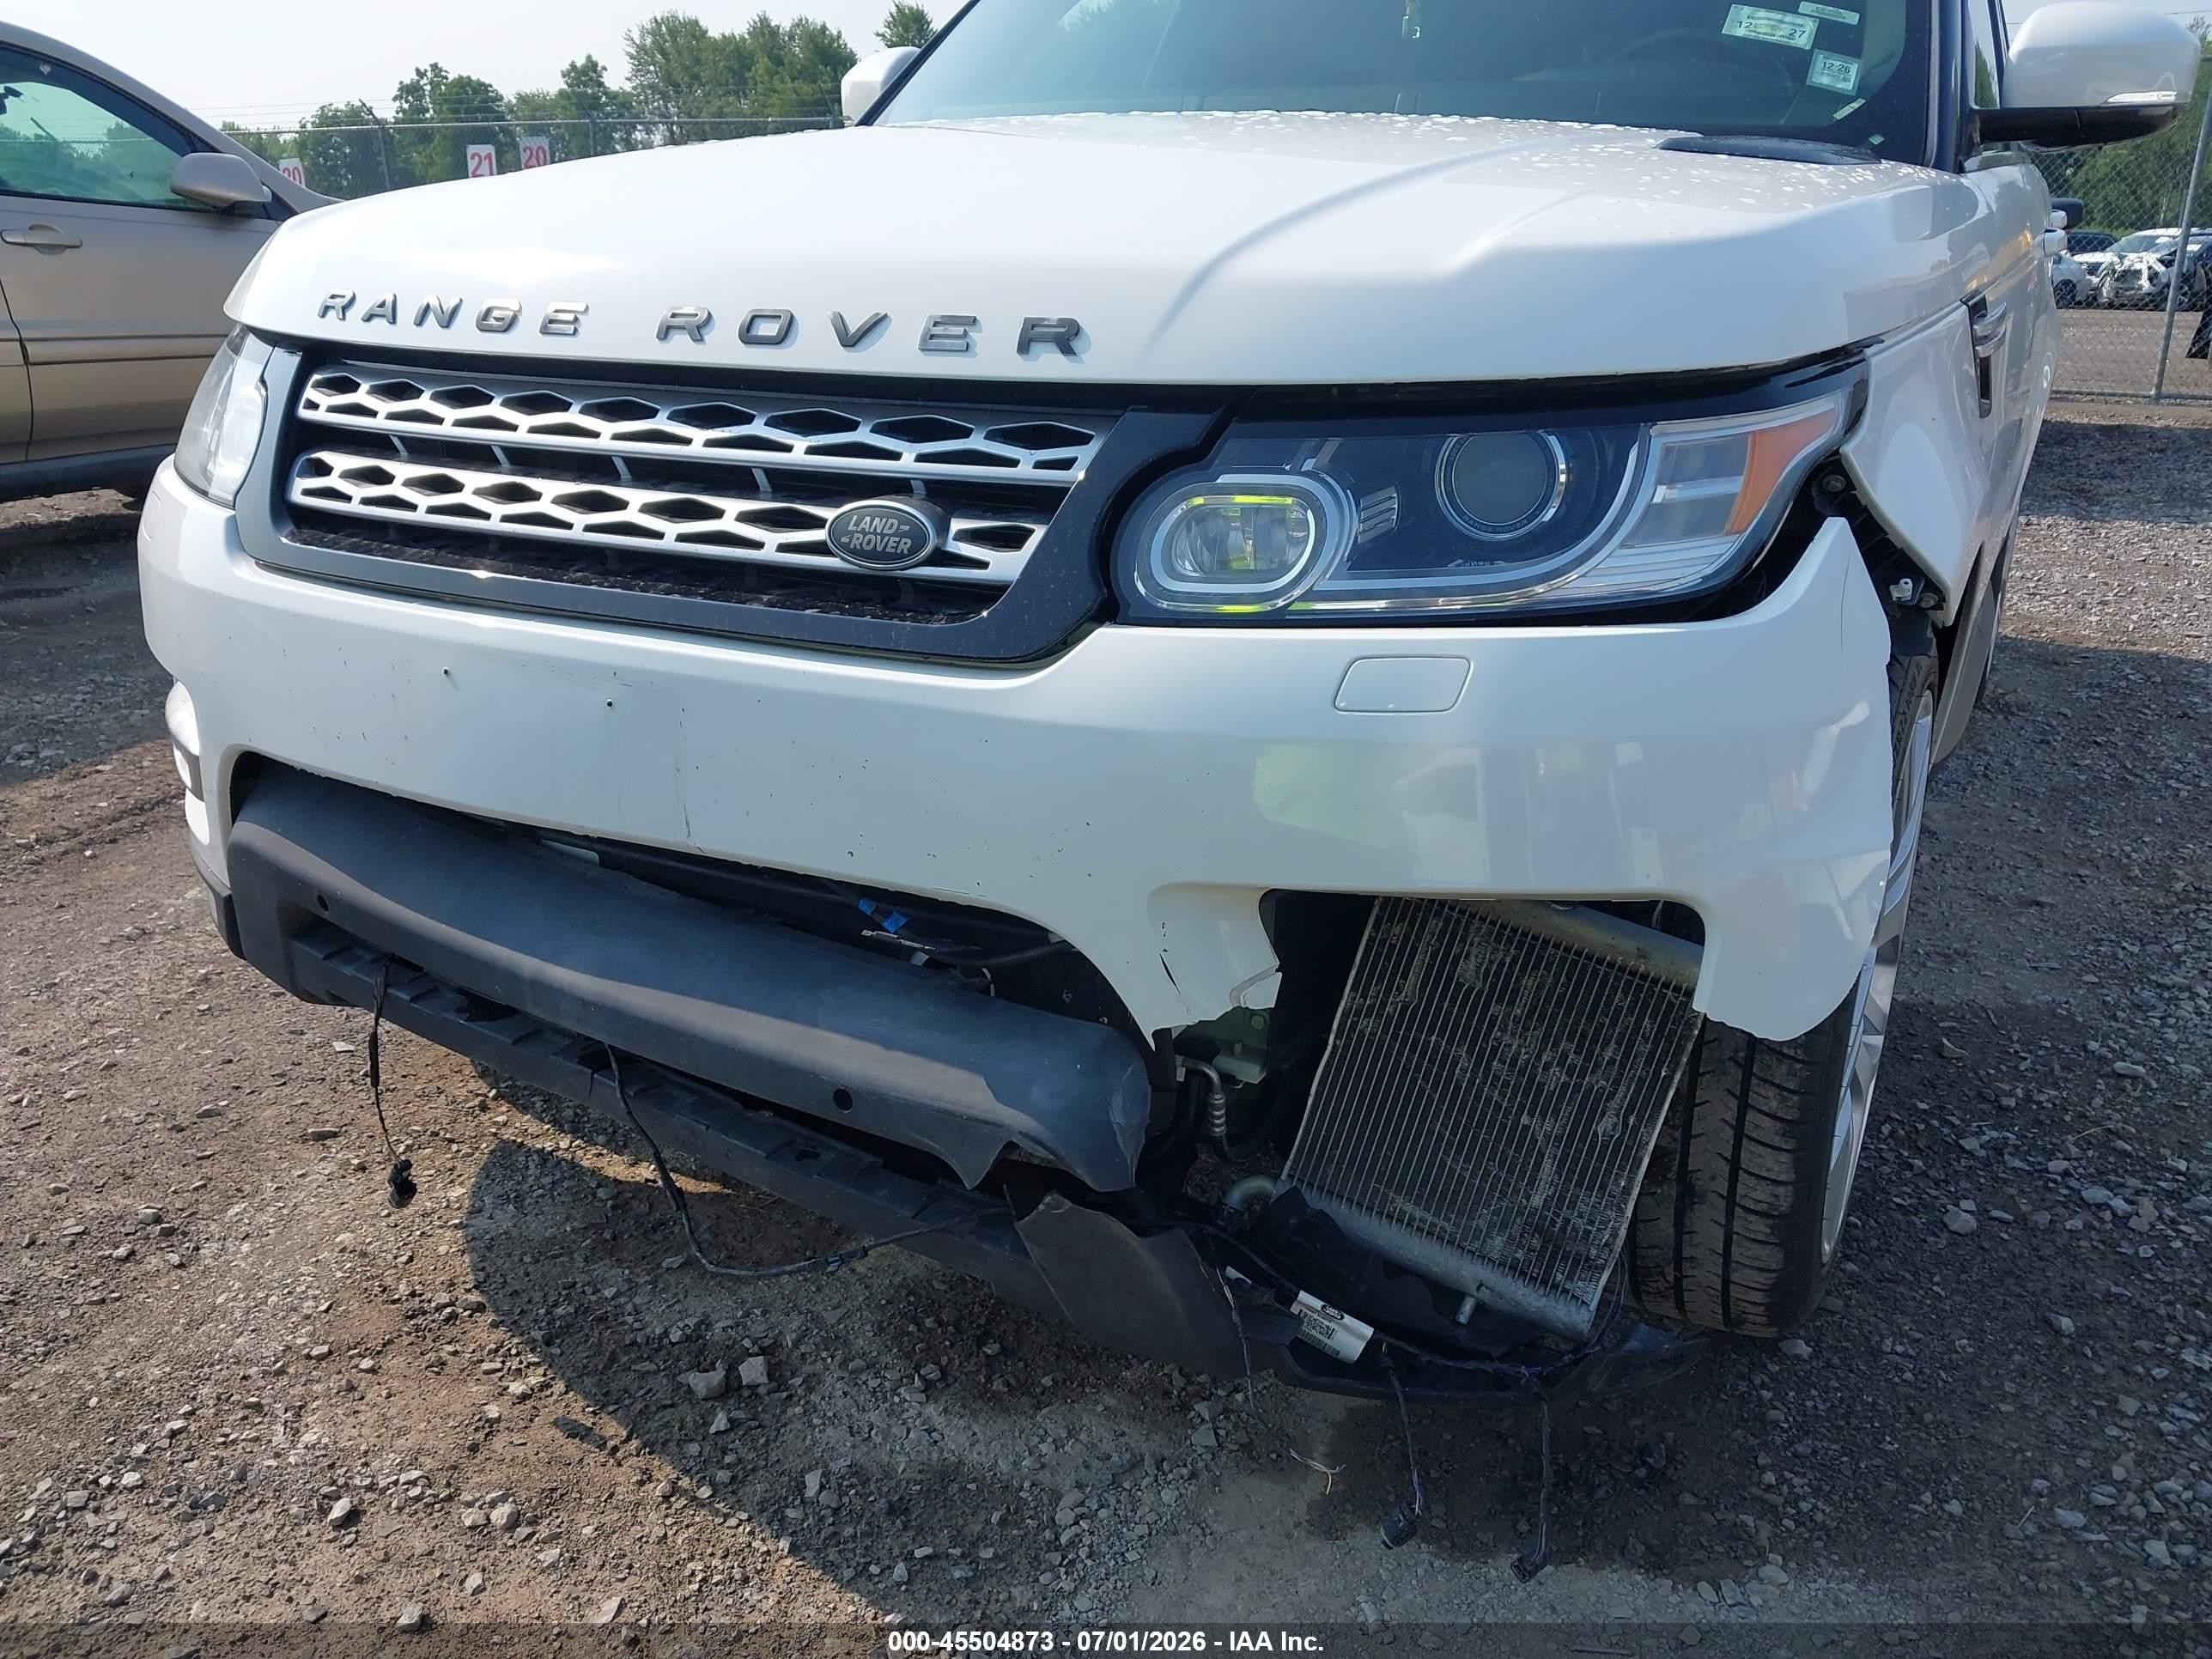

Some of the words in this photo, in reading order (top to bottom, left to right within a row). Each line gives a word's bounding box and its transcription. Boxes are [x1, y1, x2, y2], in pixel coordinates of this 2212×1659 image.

[1789, 28, 1807, 38] 27
[470, 151, 495, 178] 21
[522, 145, 548, 169] 20
[317, 288, 588, 336] RANGE
[655, 306, 1083, 356] ROVER
[848, 515, 898, 534] LAND
[849, 532, 912, 554] ROVER
